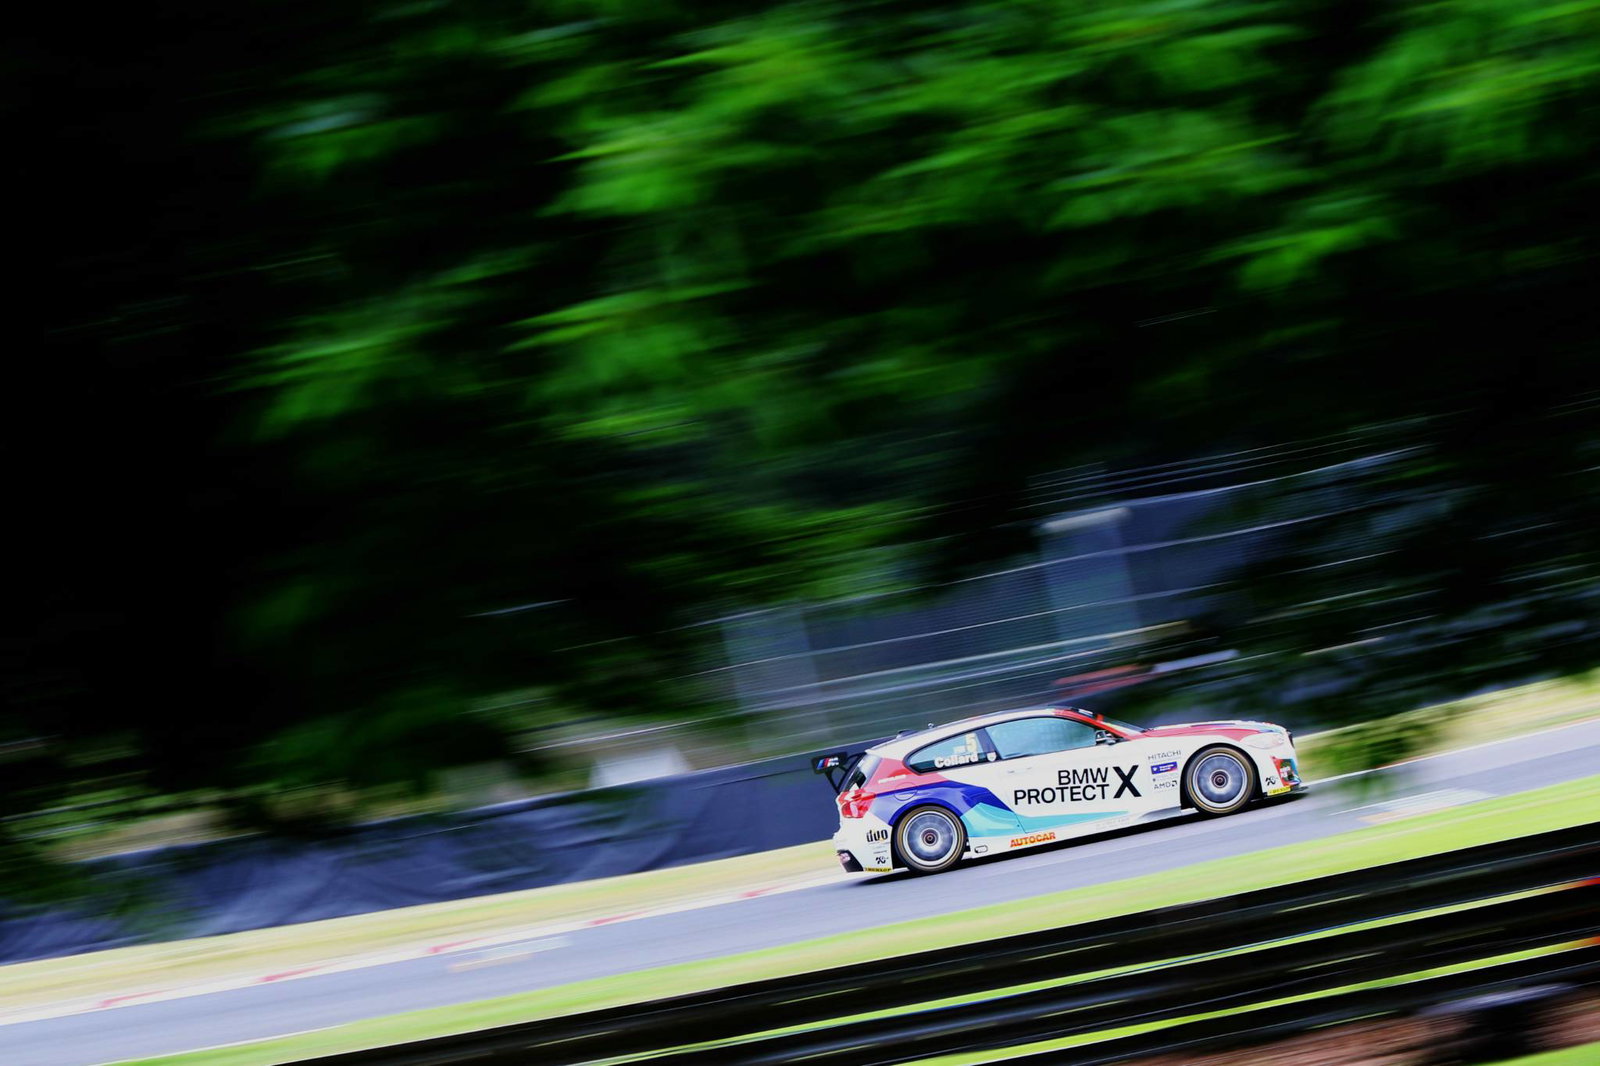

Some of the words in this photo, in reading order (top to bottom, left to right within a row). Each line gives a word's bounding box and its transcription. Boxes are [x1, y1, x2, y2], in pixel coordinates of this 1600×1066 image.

[934, 752, 979, 768] Collard
[1148, 750, 1182, 760] HITACHI
[1058, 767, 1108, 785] BMW
[1014, 784, 1109, 805] PROTECT
[1112, 765, 1142, 799] X
[1154, 781, 1171, 789] AMD
[866, 829, 889, 842] duo
[1010, 832, 1056, 848] AUTOCAR
